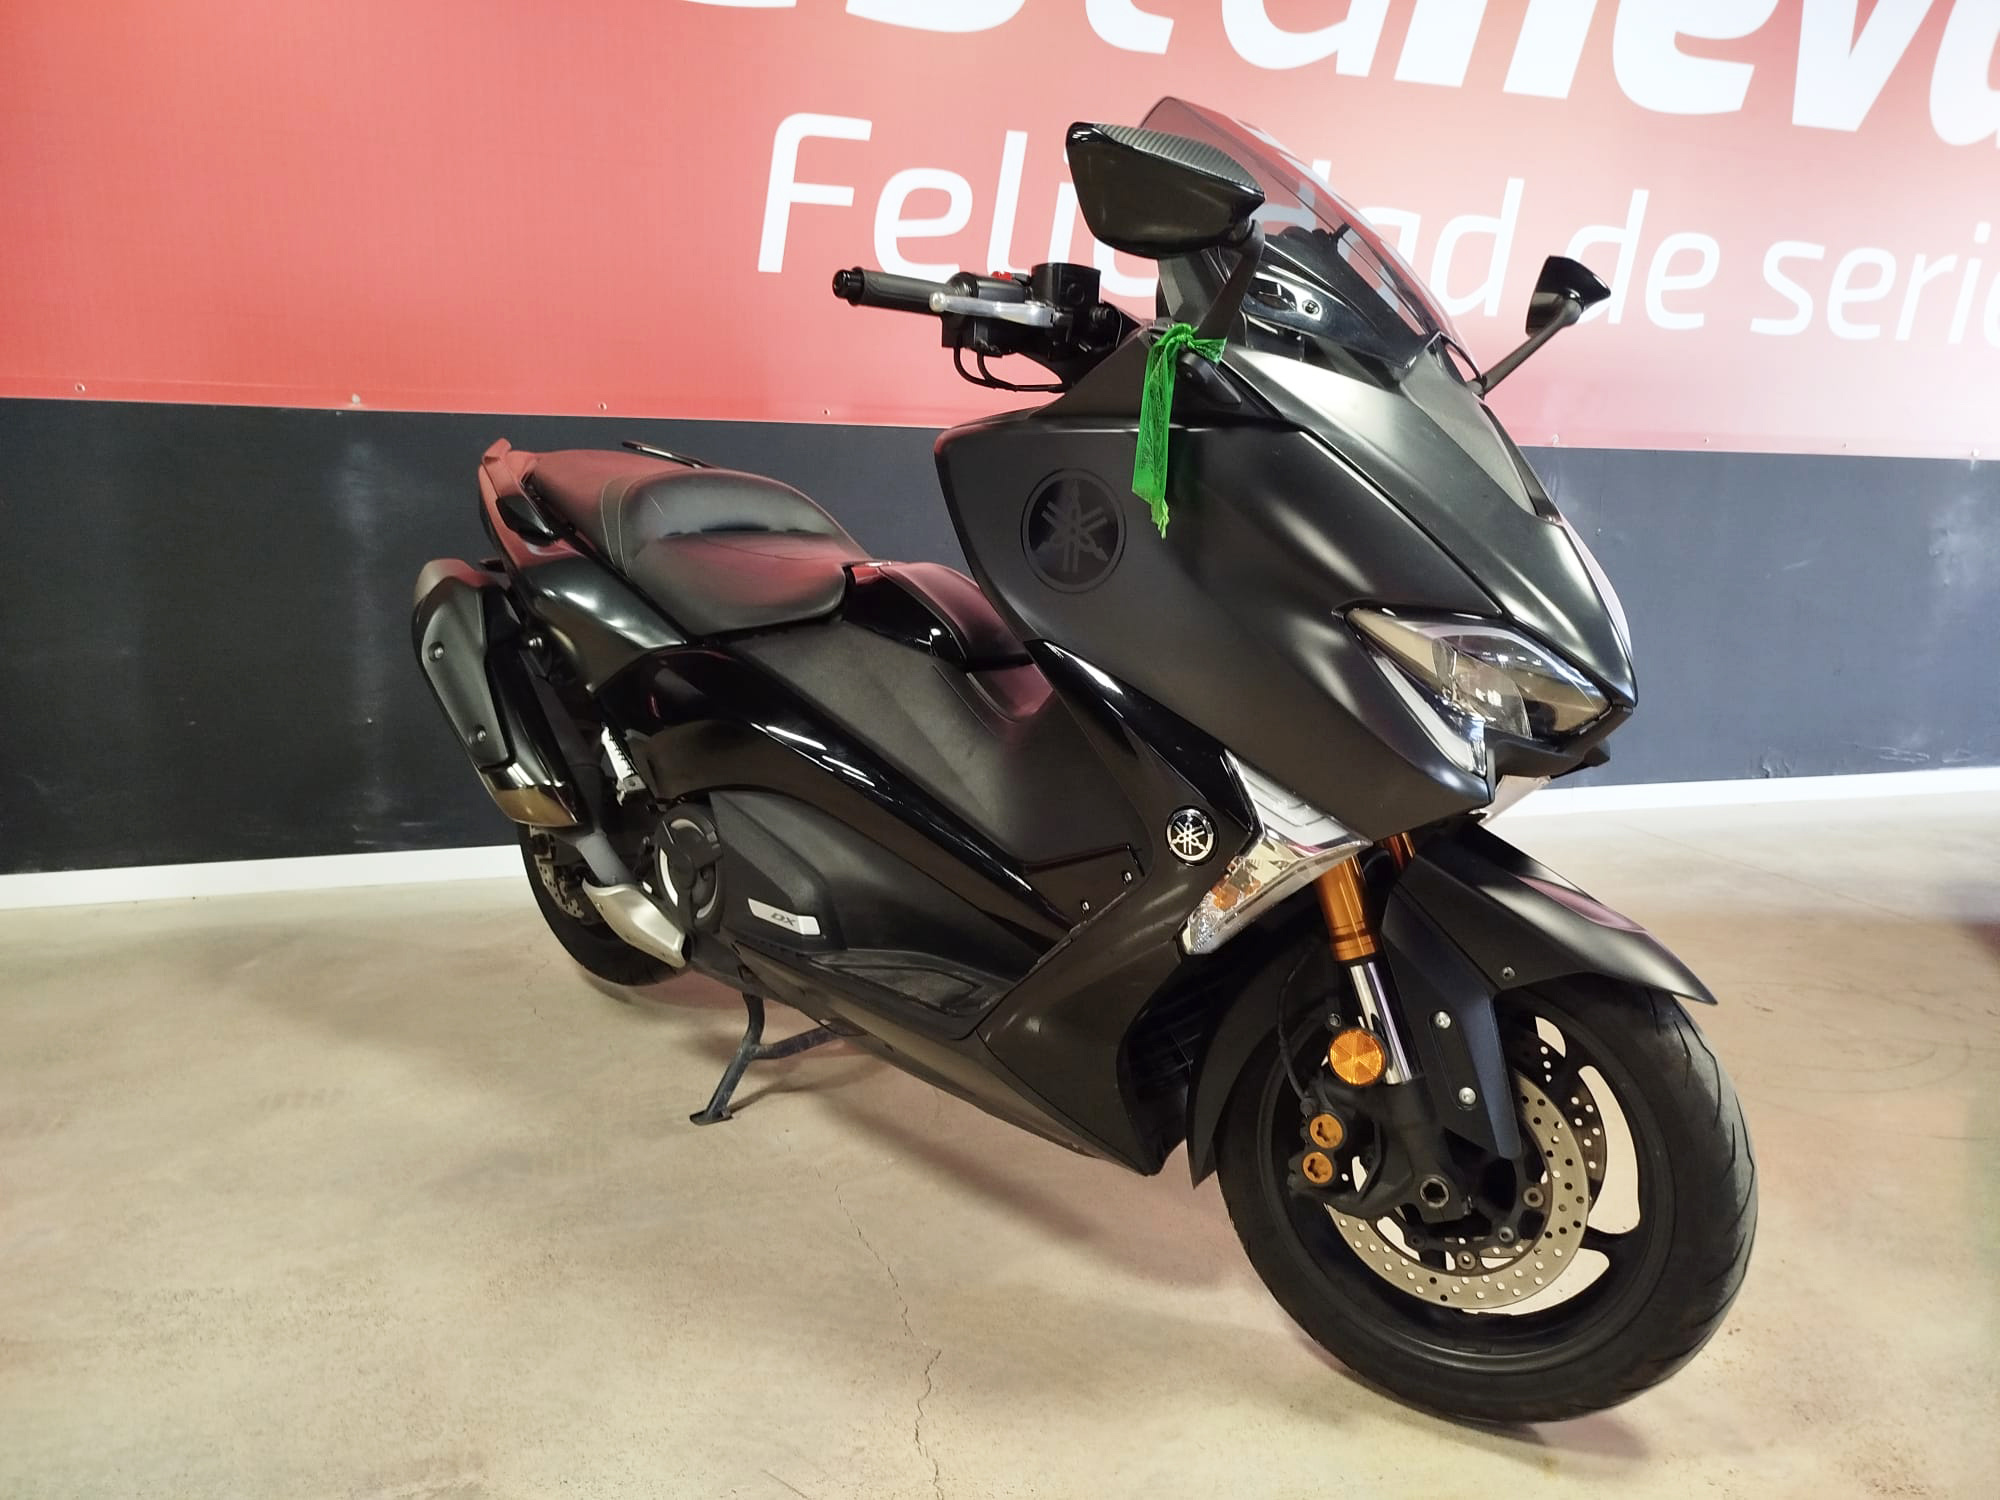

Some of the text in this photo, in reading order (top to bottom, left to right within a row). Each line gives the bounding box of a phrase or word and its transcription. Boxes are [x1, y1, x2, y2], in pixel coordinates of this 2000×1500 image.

[1564, 189, 1720, 330] de
[1750, 221, 2000, 349] seri
[771, 912, 796, 926] DX
